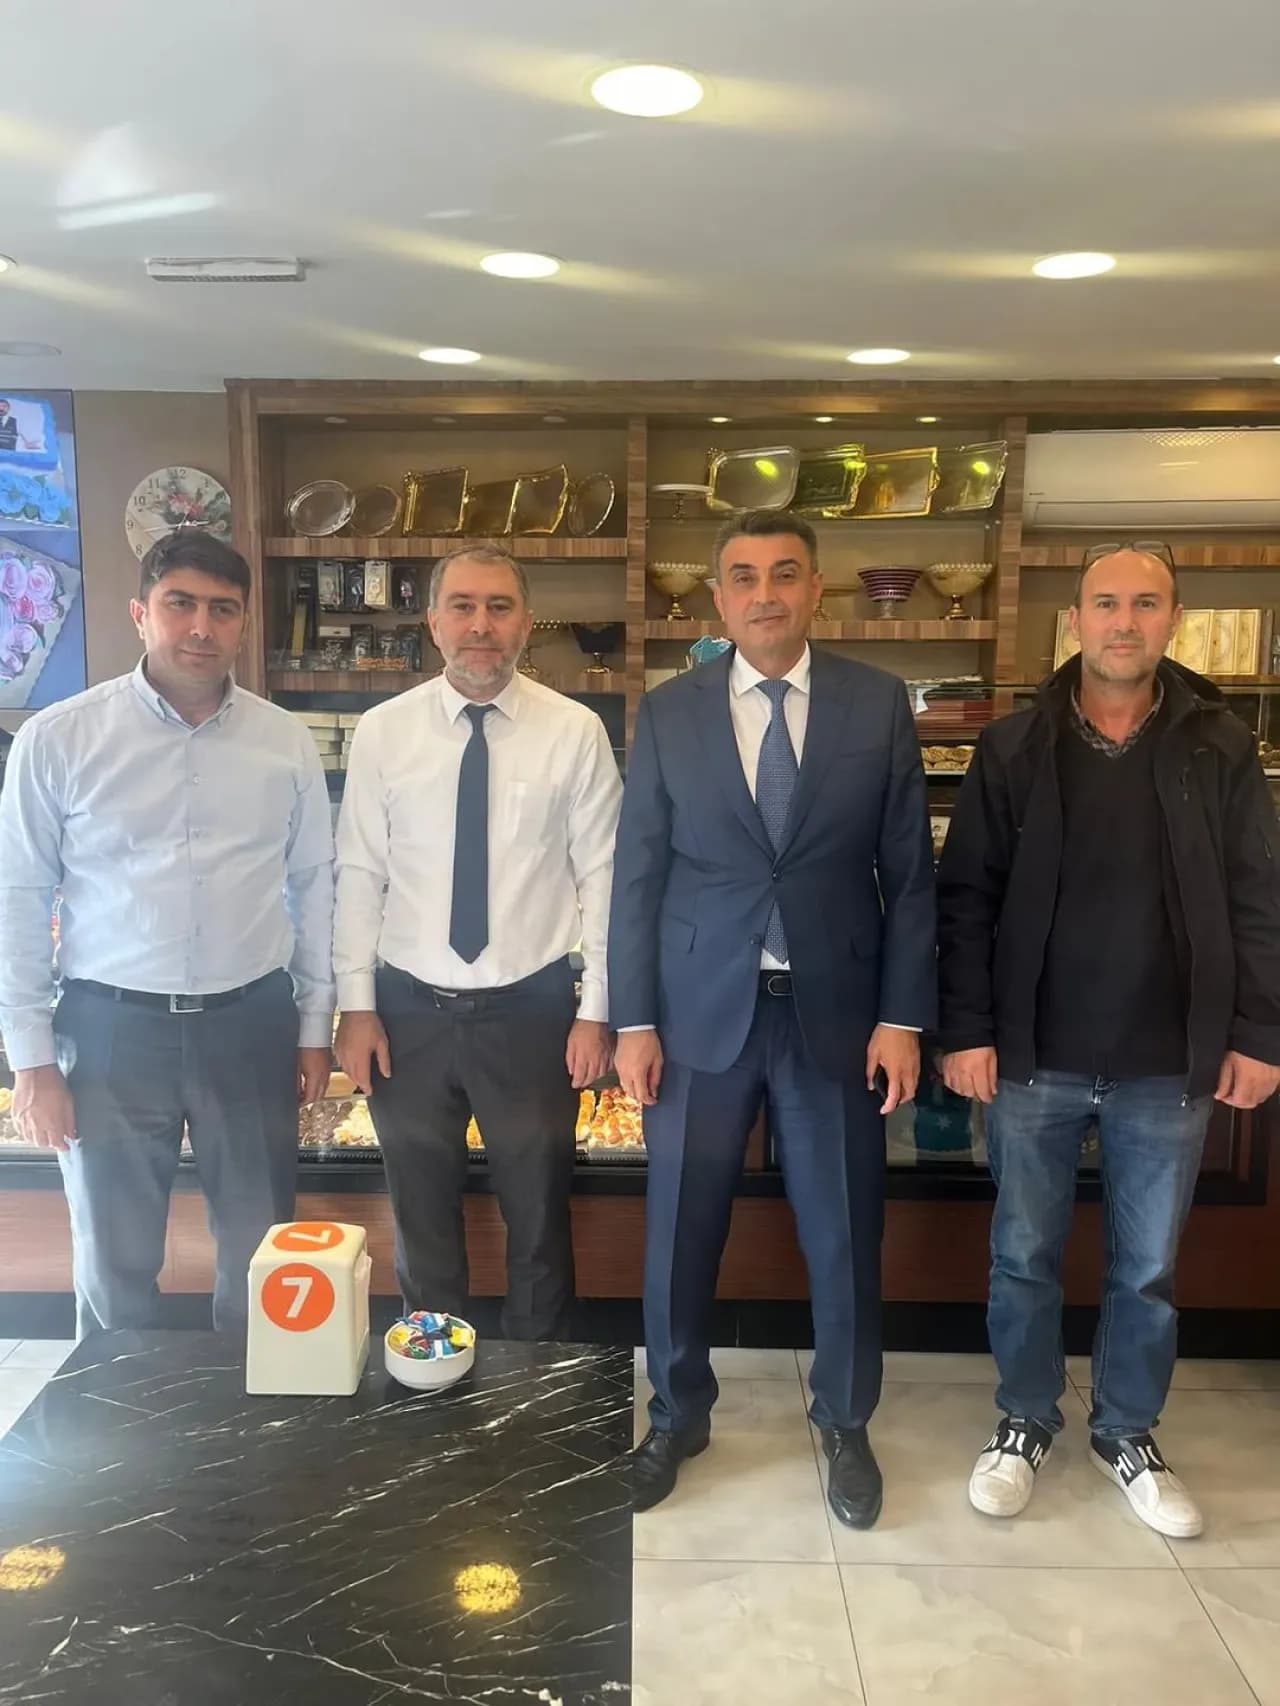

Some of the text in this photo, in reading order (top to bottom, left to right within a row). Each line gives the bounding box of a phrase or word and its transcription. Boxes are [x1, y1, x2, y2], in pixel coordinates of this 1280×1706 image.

[173, 469, 186, 479] 12
[148, 478, 160, 489] 11
[133, 496, 146, 506] 10
[127, 520, 134, 530] 9
[135, 544, 143, 555] 8
[281, 1276, 313, 1319] 7
